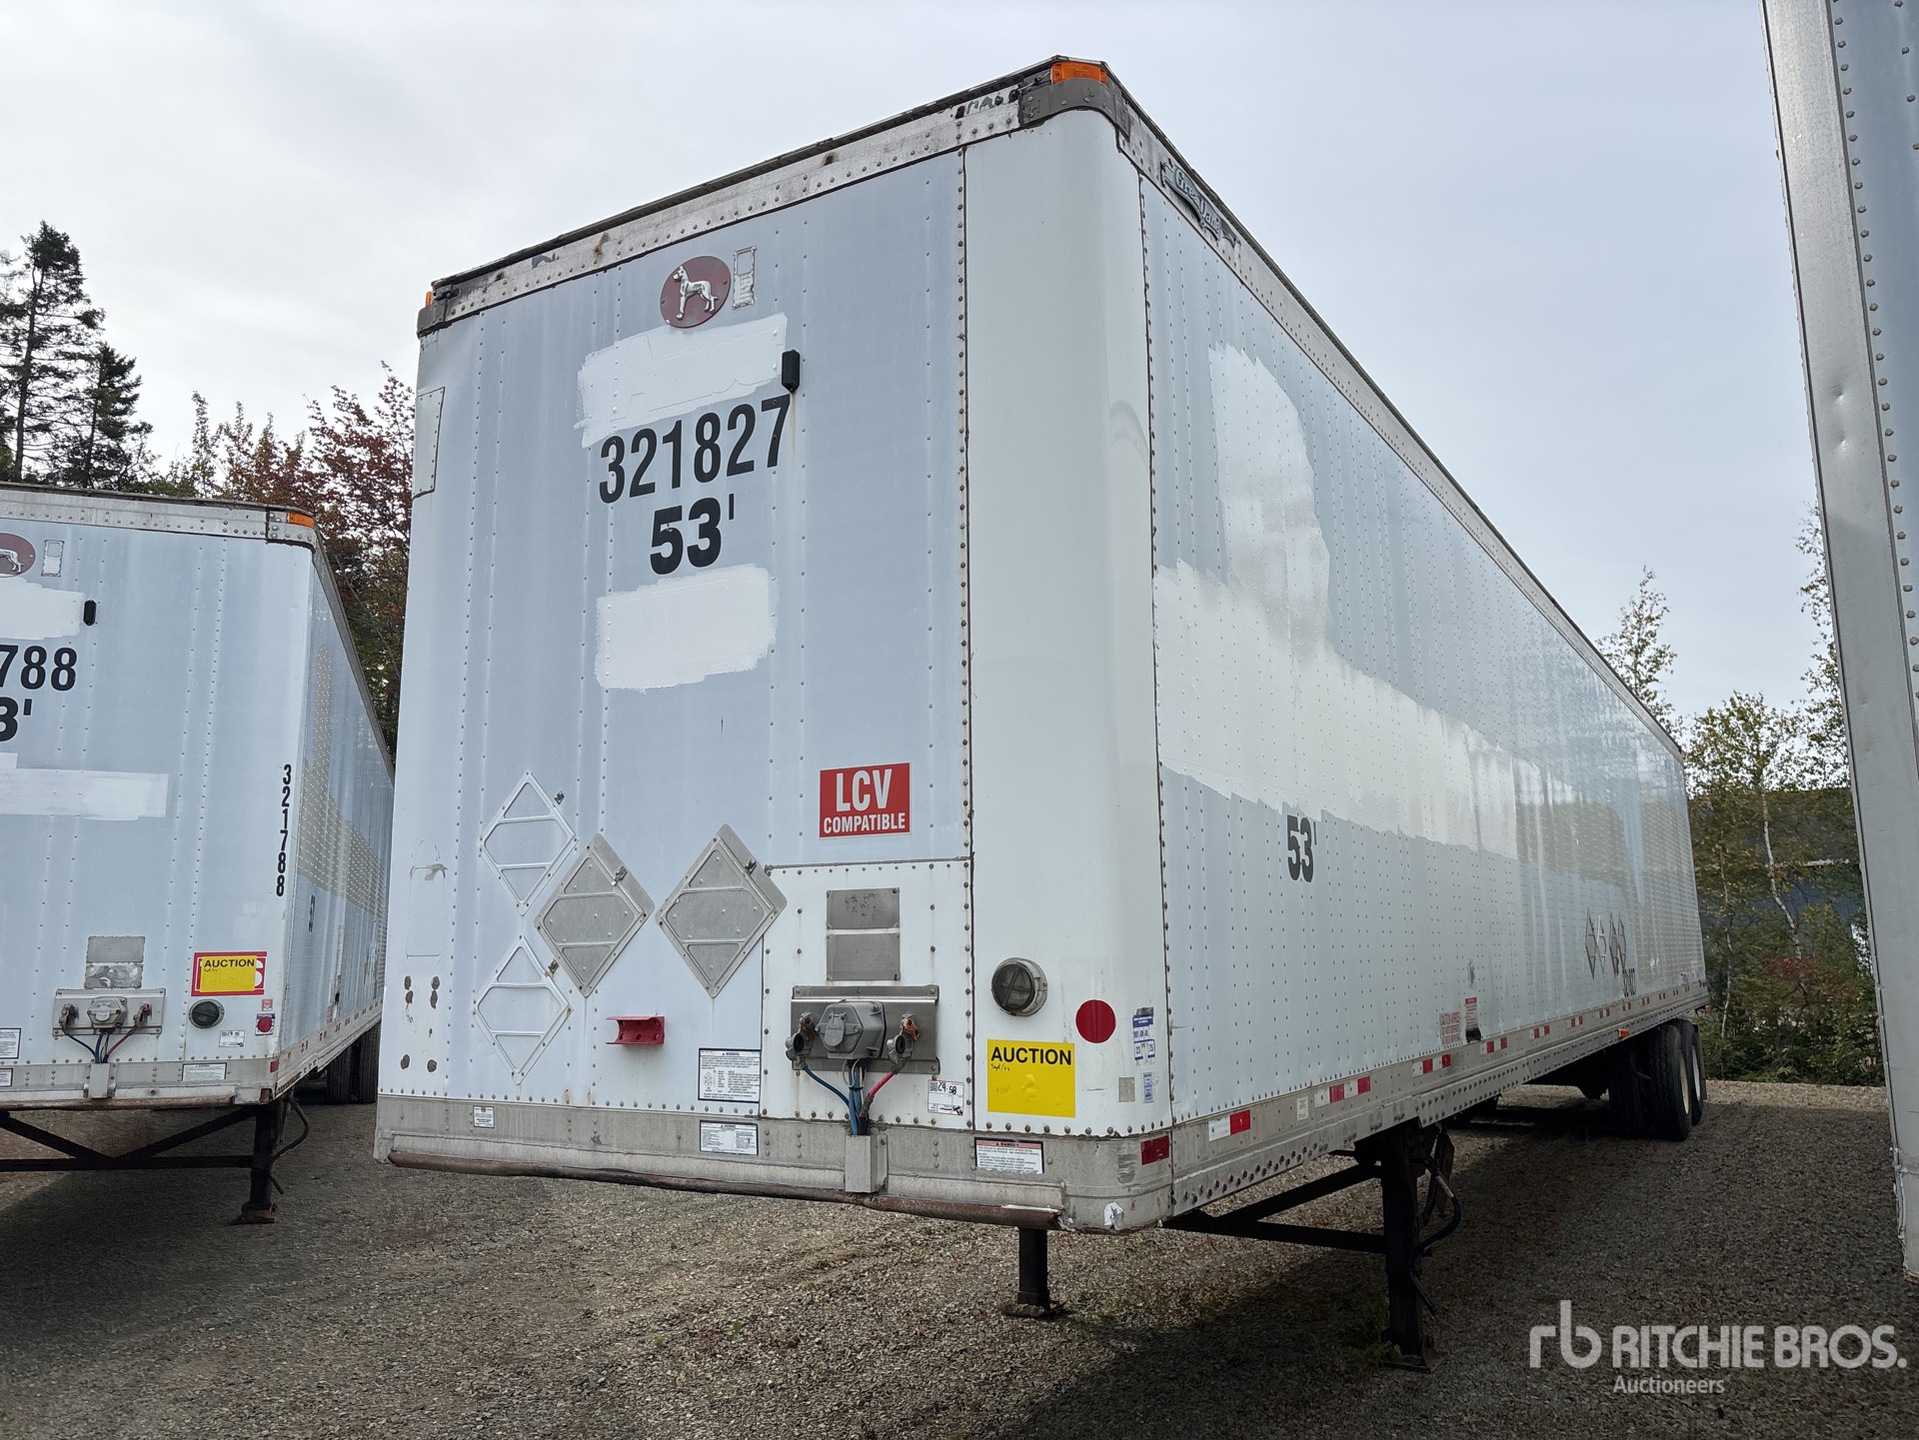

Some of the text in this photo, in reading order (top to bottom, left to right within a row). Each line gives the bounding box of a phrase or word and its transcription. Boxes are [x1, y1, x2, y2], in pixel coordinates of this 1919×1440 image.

[600, 394, 790, 503] 321827
[650, 493, 734, 575] 53'
[0, 644, 77, 691] 788
[836, 769, 892, 812] LCV
[276, 764, 292, 897] 321788
[824, 812, 905, 834] COMPATIBLE
[1287, 814, 1317, 883] 53'
[204, 958, 255, 968] AUCTION
[991, 1046, 1072, 1066] AUCTION
